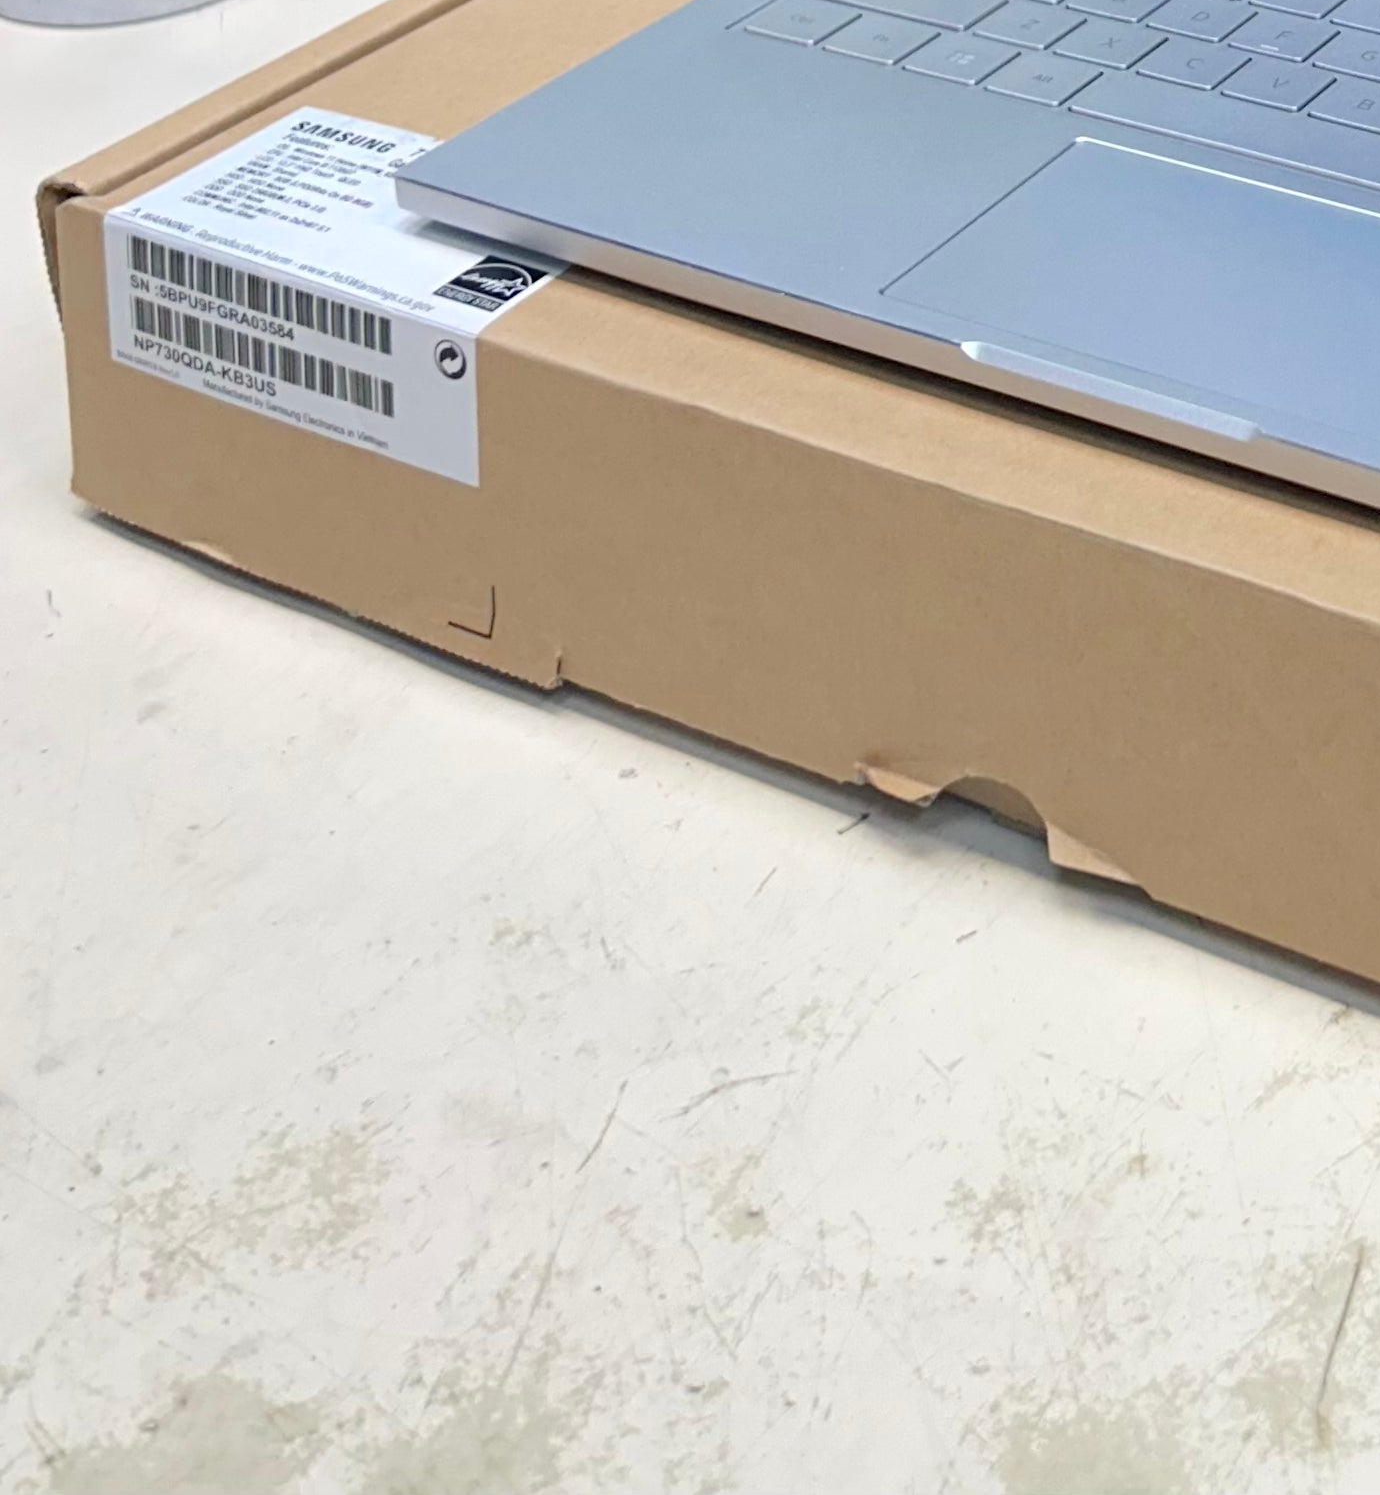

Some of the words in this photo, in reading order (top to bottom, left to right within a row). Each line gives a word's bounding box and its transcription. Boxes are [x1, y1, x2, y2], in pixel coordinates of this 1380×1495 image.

[1191, 10, 1211, 22] D
[1273, 30, 1294, 41] F
[1098, 37, 1118, 49] X
[1361, 49, 1380, 62] G
[1186, 57, 1206, 70] C
[1272, 76, 1290, 89] V
[1355, 98, 1376, 110] B
[291, 121, 397, 154] SAMSUNG
[129, 275, 150, 294] SN
[133, 334, 278, 397] NP730QDA-KB3US
[265, 398, 301, 423] Samsung
